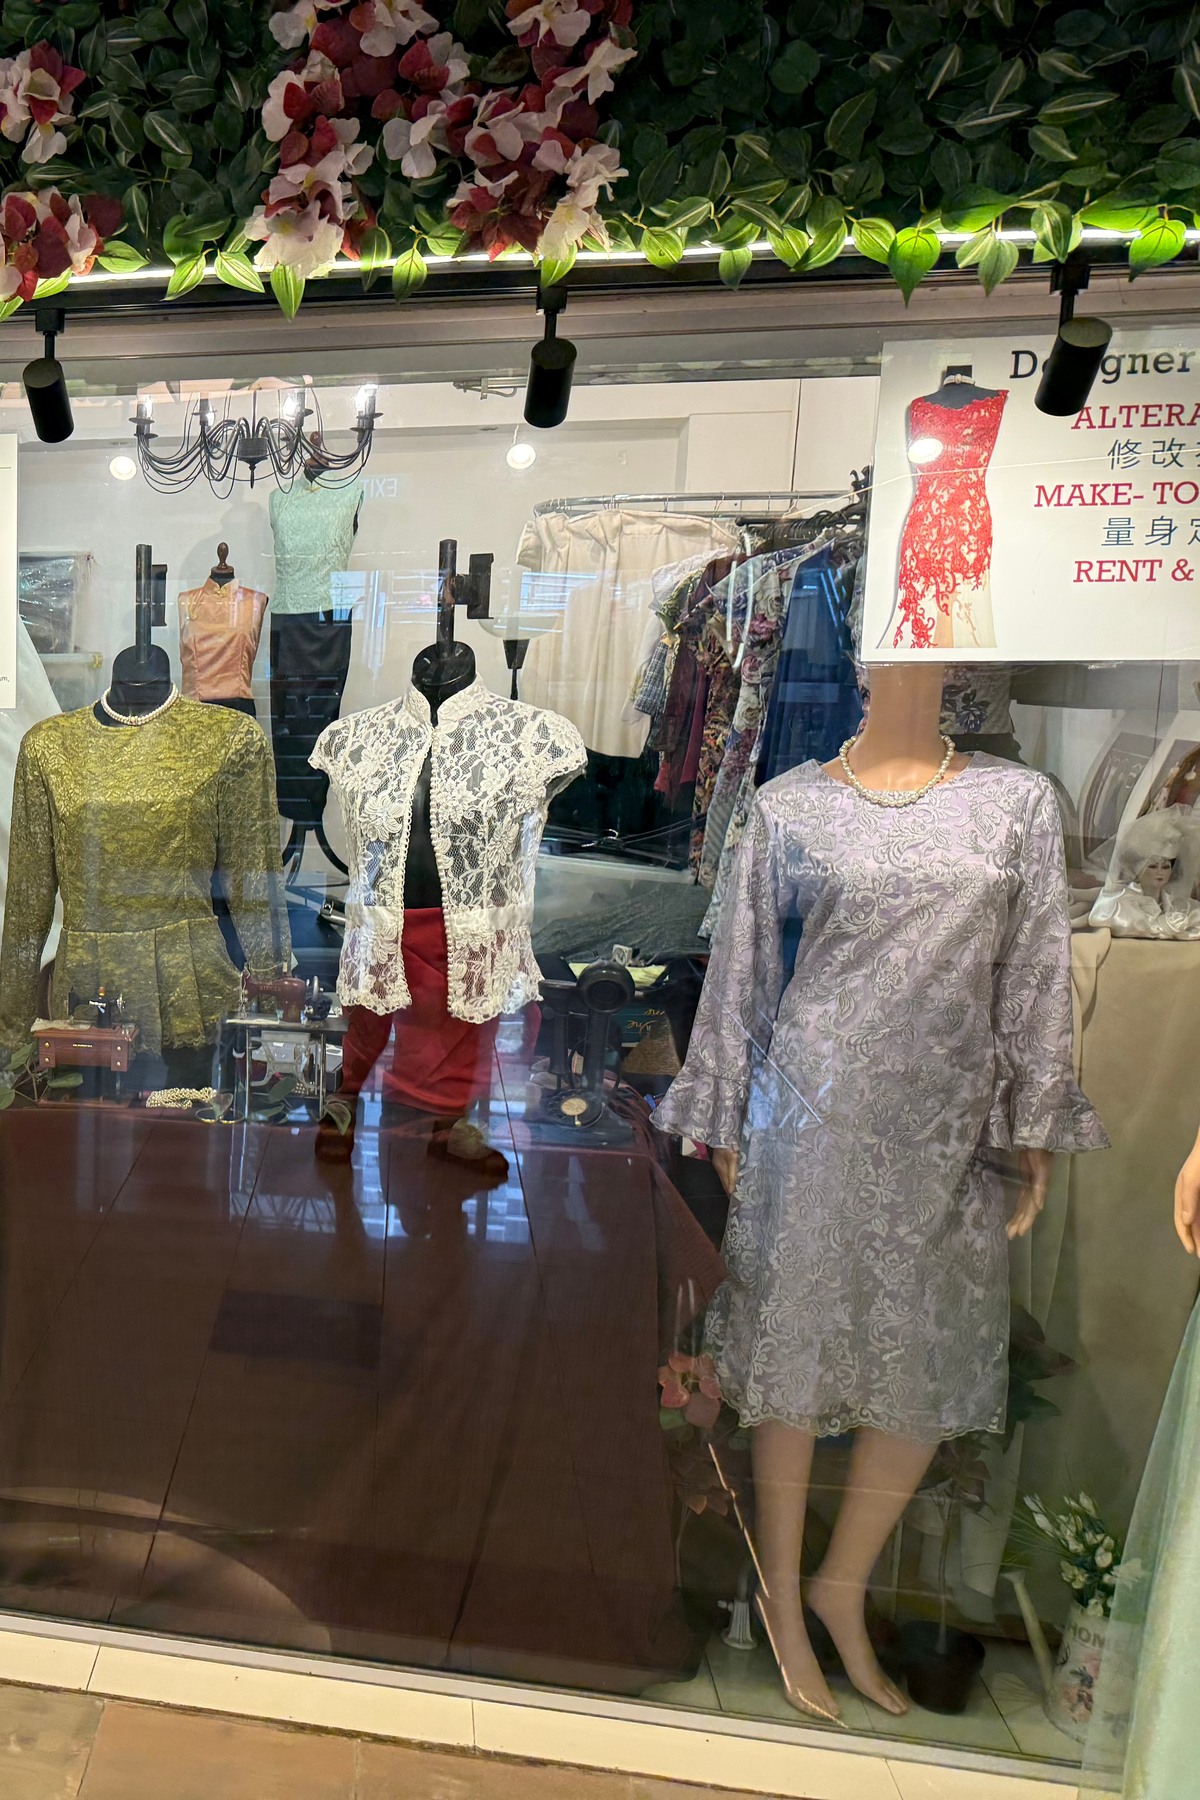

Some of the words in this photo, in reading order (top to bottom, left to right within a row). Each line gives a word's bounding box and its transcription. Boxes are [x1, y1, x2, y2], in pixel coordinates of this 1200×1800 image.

[1009, 349, 1196, 385] Dgner
[1107, 437, 1200, 471] 修改
[1034, 482, 1145, 508] MAKE-
[1153, 480, 1200, 505] TO
[1073, 559, 1163, 583] RENT
[1171, 558, 1195, 582] &
